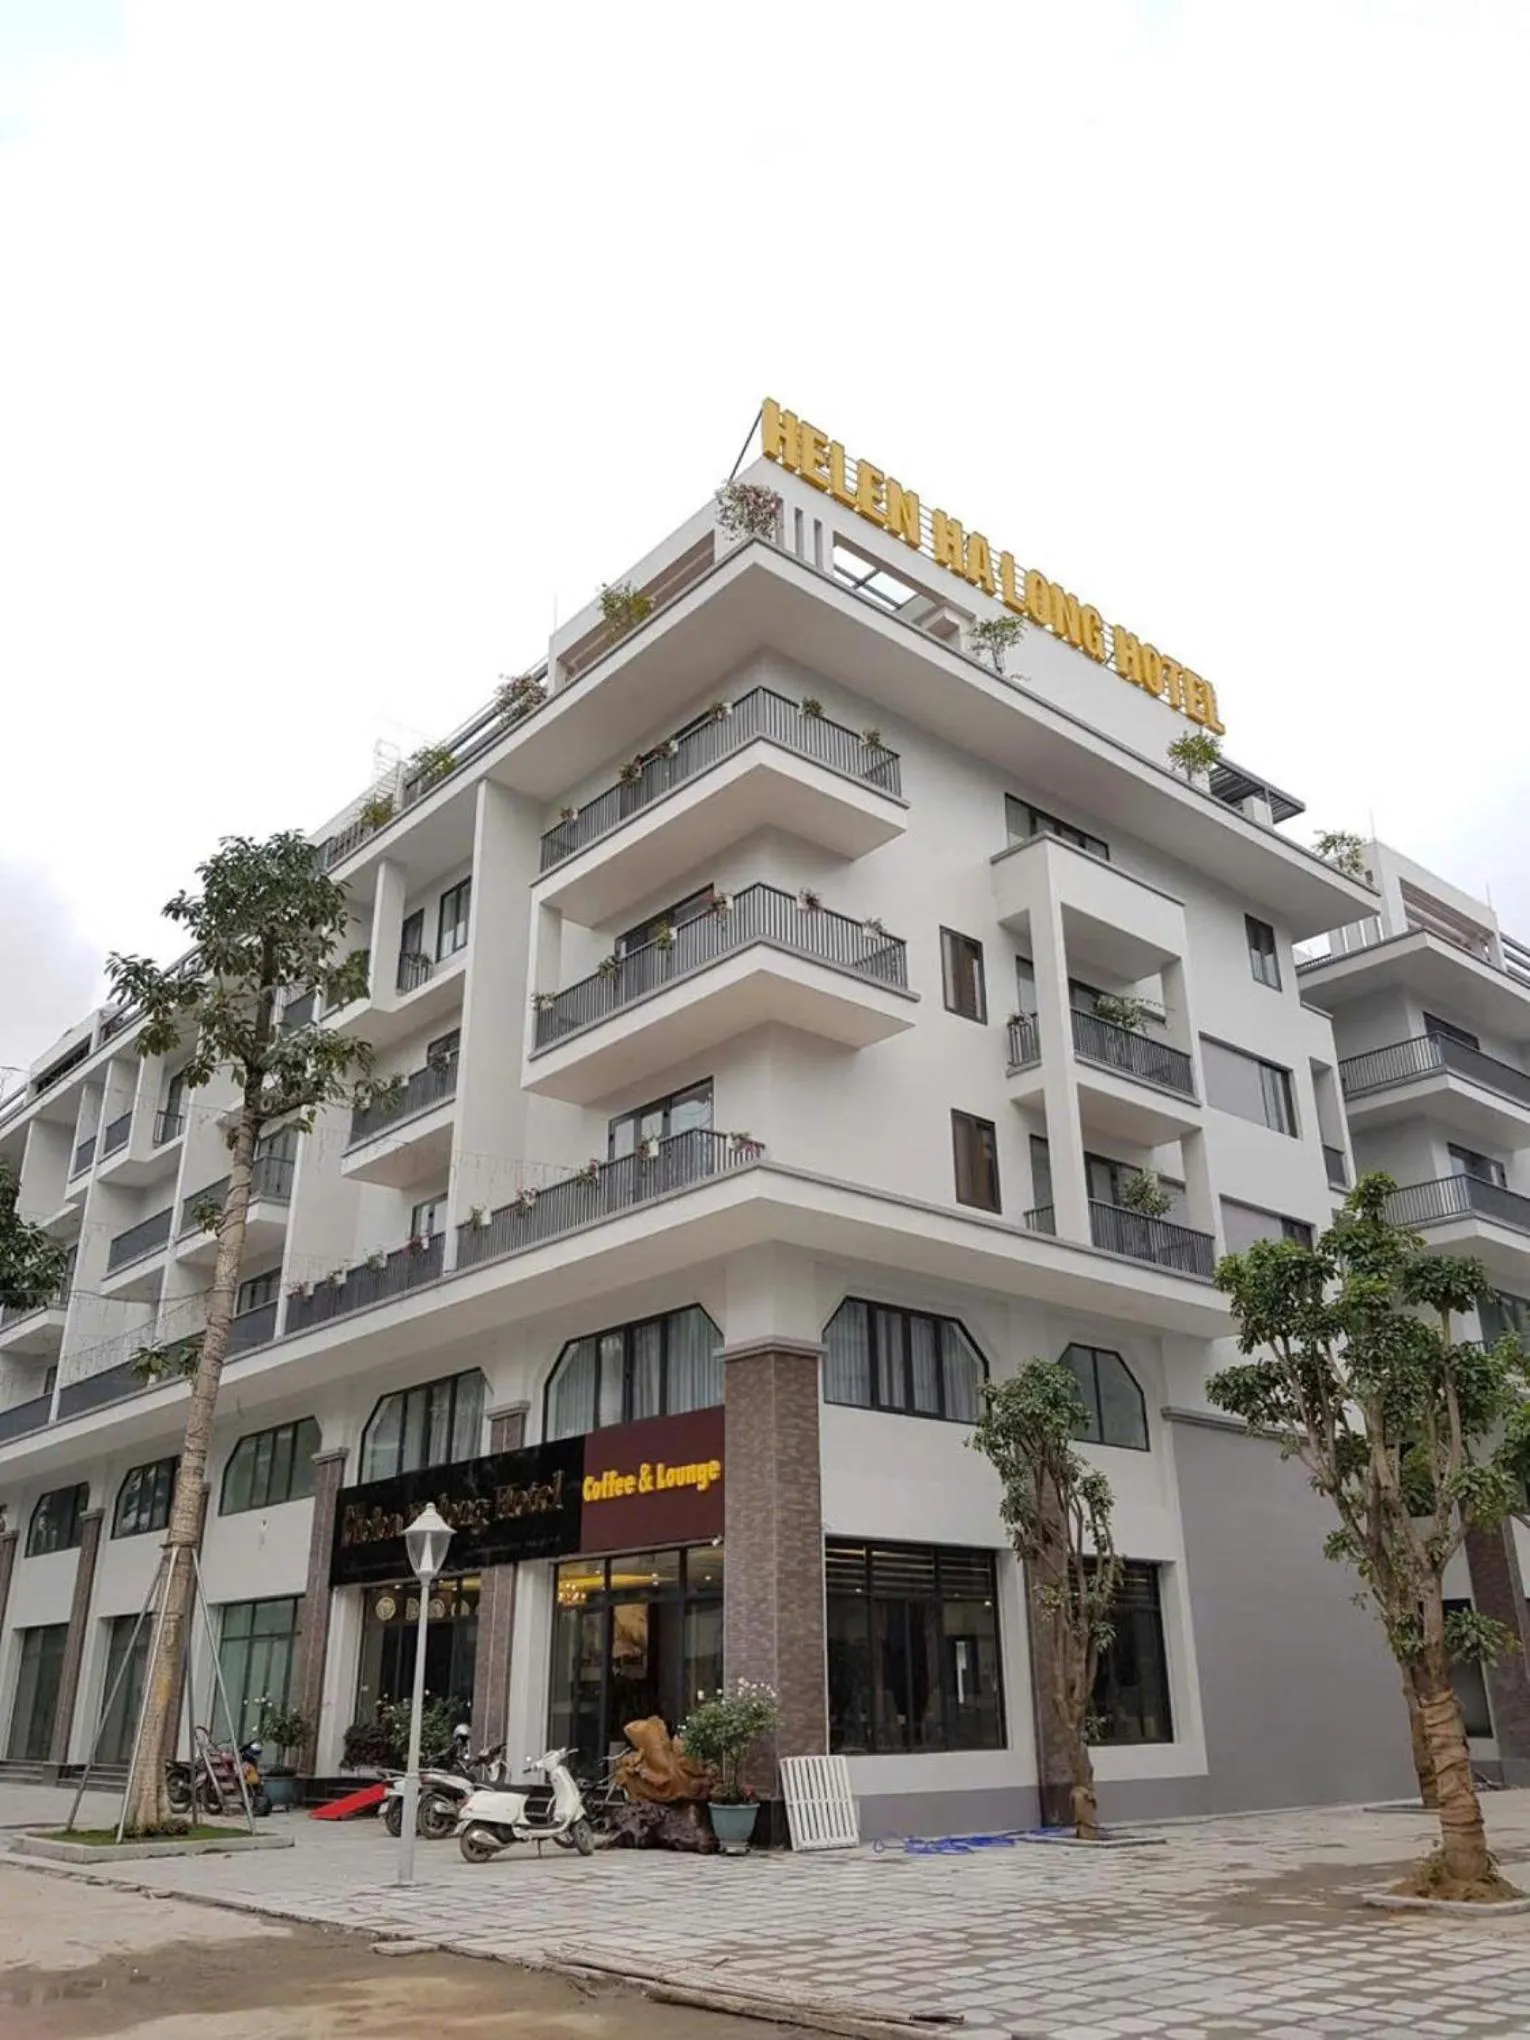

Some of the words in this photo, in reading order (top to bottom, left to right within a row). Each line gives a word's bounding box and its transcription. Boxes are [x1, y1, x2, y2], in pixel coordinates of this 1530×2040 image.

[762, 397, 920, 551] HELEN
[1113, 624, 1226, 737] HOTEL
[582, 1470, 637, 1502] Coffee
[638, 1462, 655, 1493] &
[656, 1459, 721, 1491] Lounge
